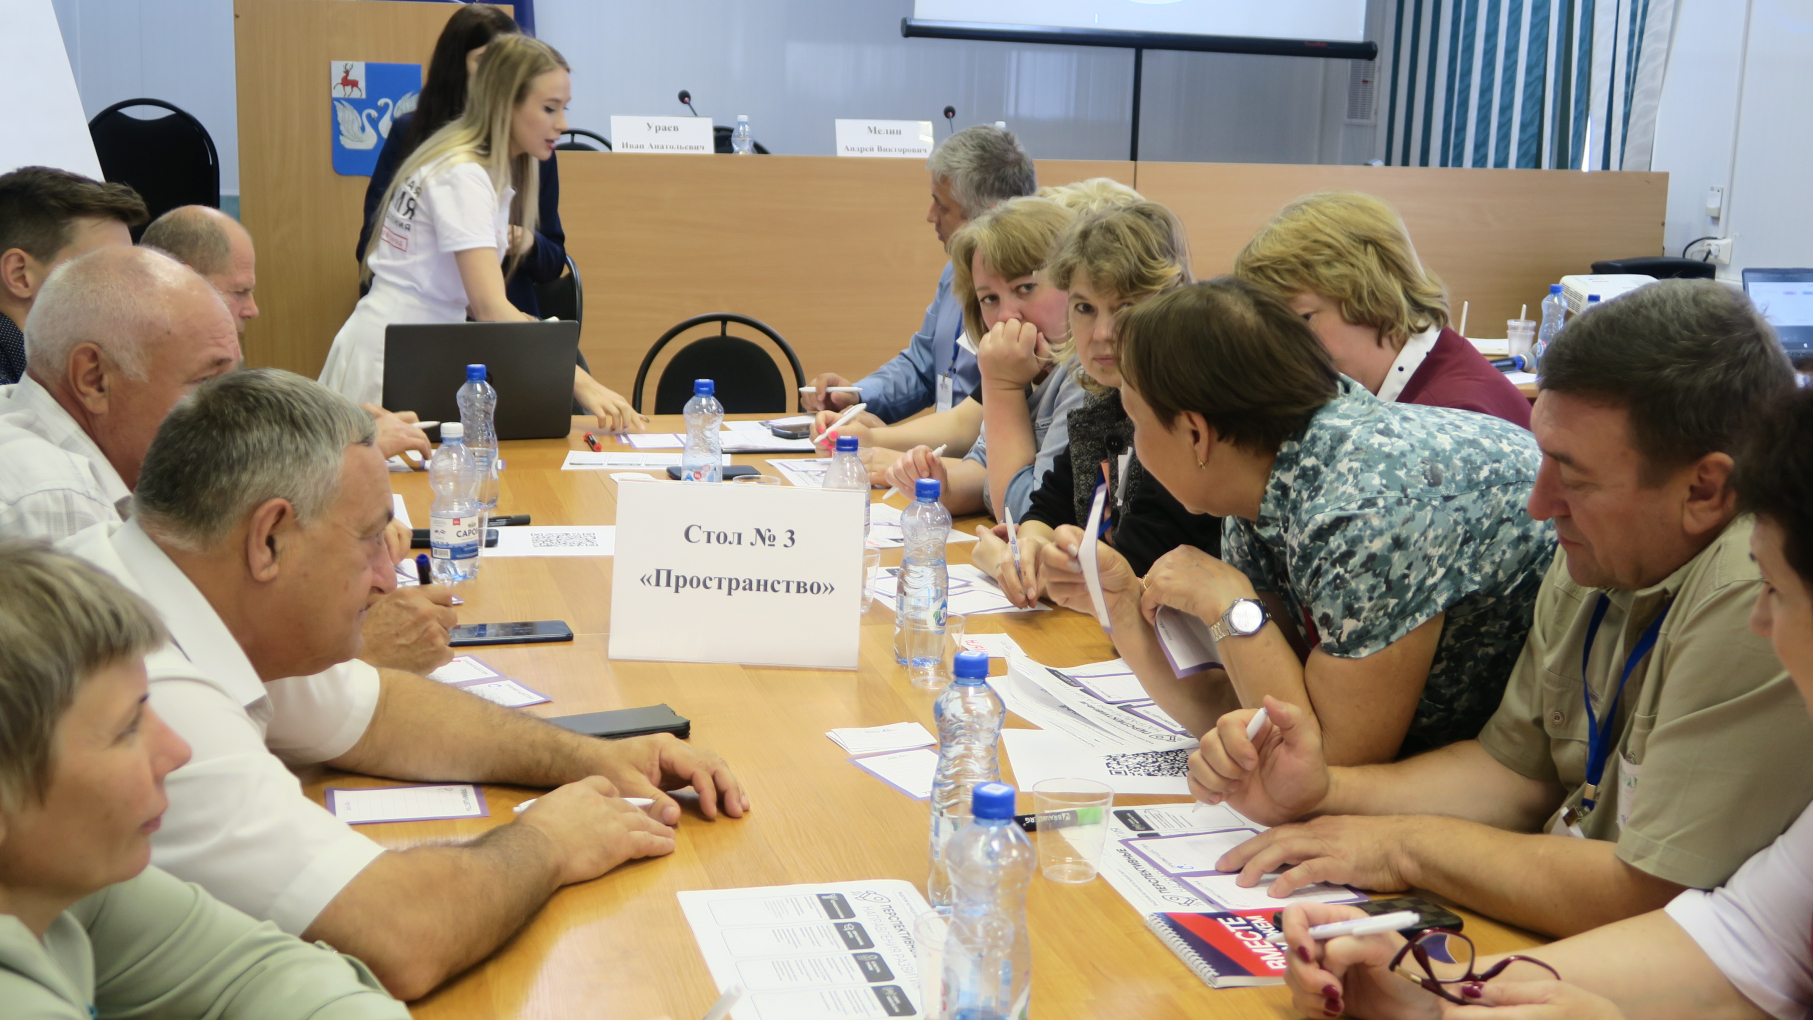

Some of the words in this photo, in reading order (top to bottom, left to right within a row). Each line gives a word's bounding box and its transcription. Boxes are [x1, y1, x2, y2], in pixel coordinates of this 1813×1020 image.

[646, 122, 679, 134] Ураев
[867, 126, 902, 135] Мелин
[621, 141, 645, 150] Иван
[647, 142, 705, 151] Анатольевич
[843, 144, 874, 154] Андрей
[877, 145, 927, 155] Викторович
[683, 523, 743, 546] Стол
[750, 528, 777, 547] №
[783, 529, 796, 548] 3
[639, 567, 836, 597] «Пространство»
[1216, 916, 1288, 970] ВМЕСТЕ
